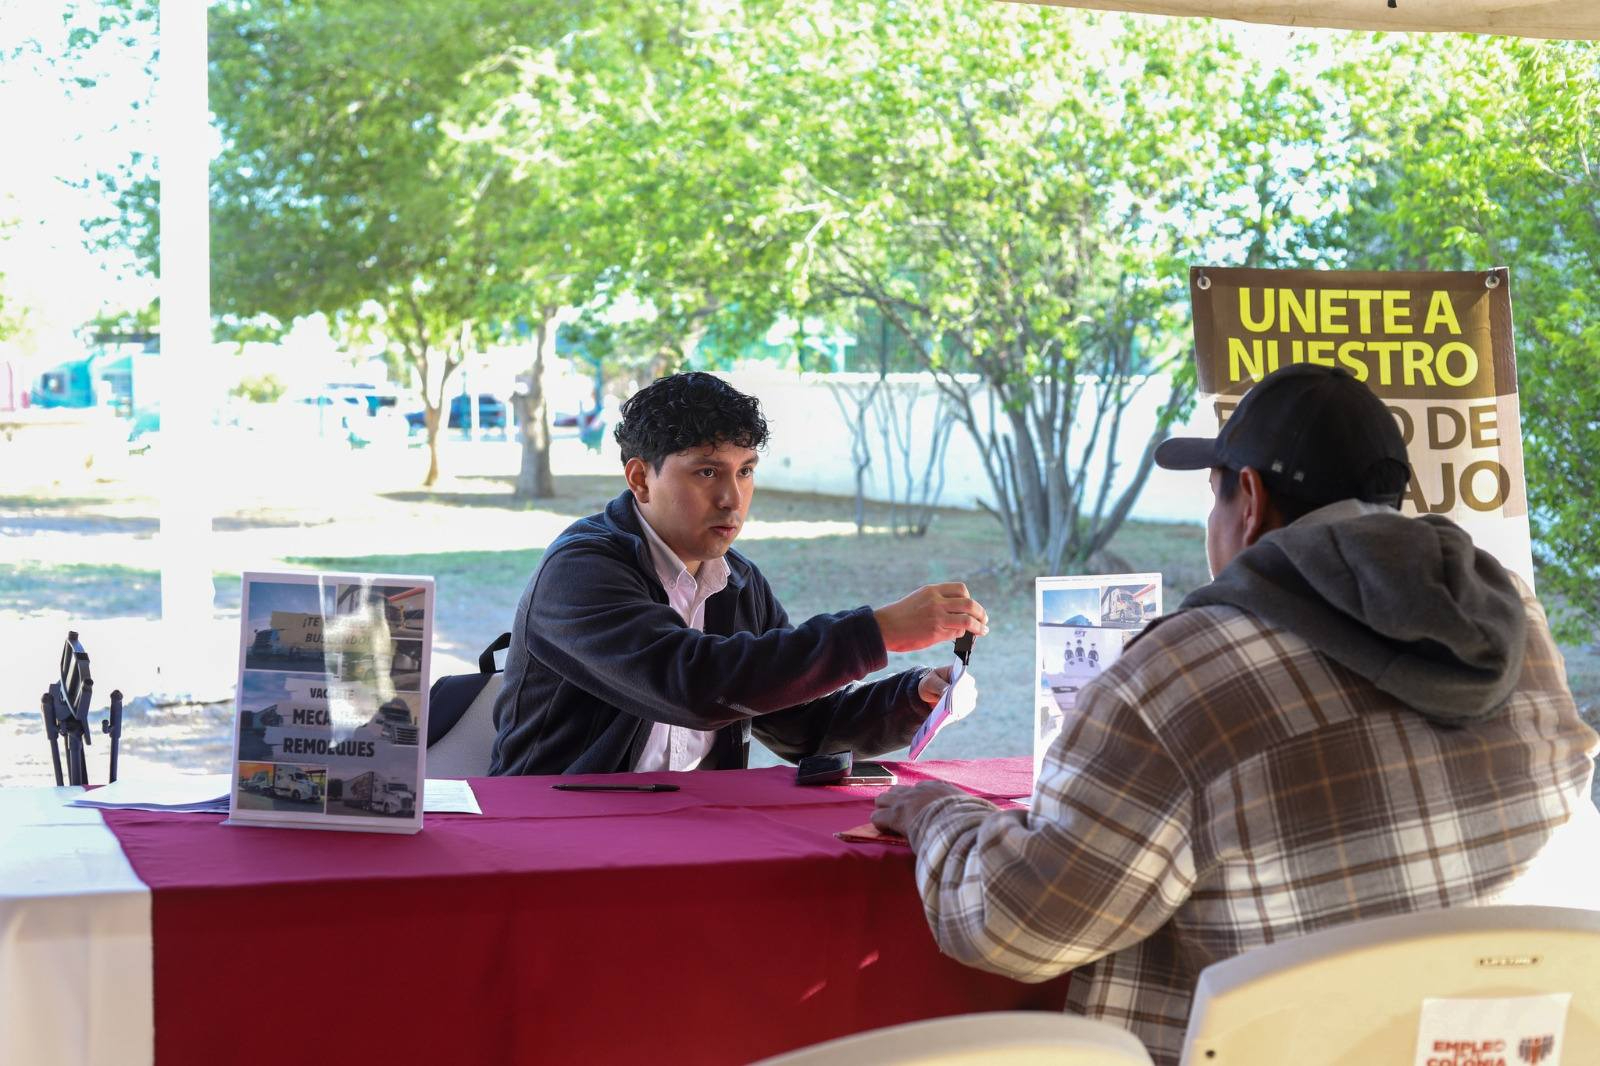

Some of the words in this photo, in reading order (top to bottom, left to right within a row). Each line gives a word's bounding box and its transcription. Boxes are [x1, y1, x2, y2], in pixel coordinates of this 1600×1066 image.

[1239, 287, 1414, 335] UNETE
[1423, 290, 1462, 335] A
[1427, 403, 1501, 450] DE
[305, 632, 371, 646] BUSNDO!
[310, 687, 355, 700] VACTE
[283, 737, 375, 758] REMOLQUES
